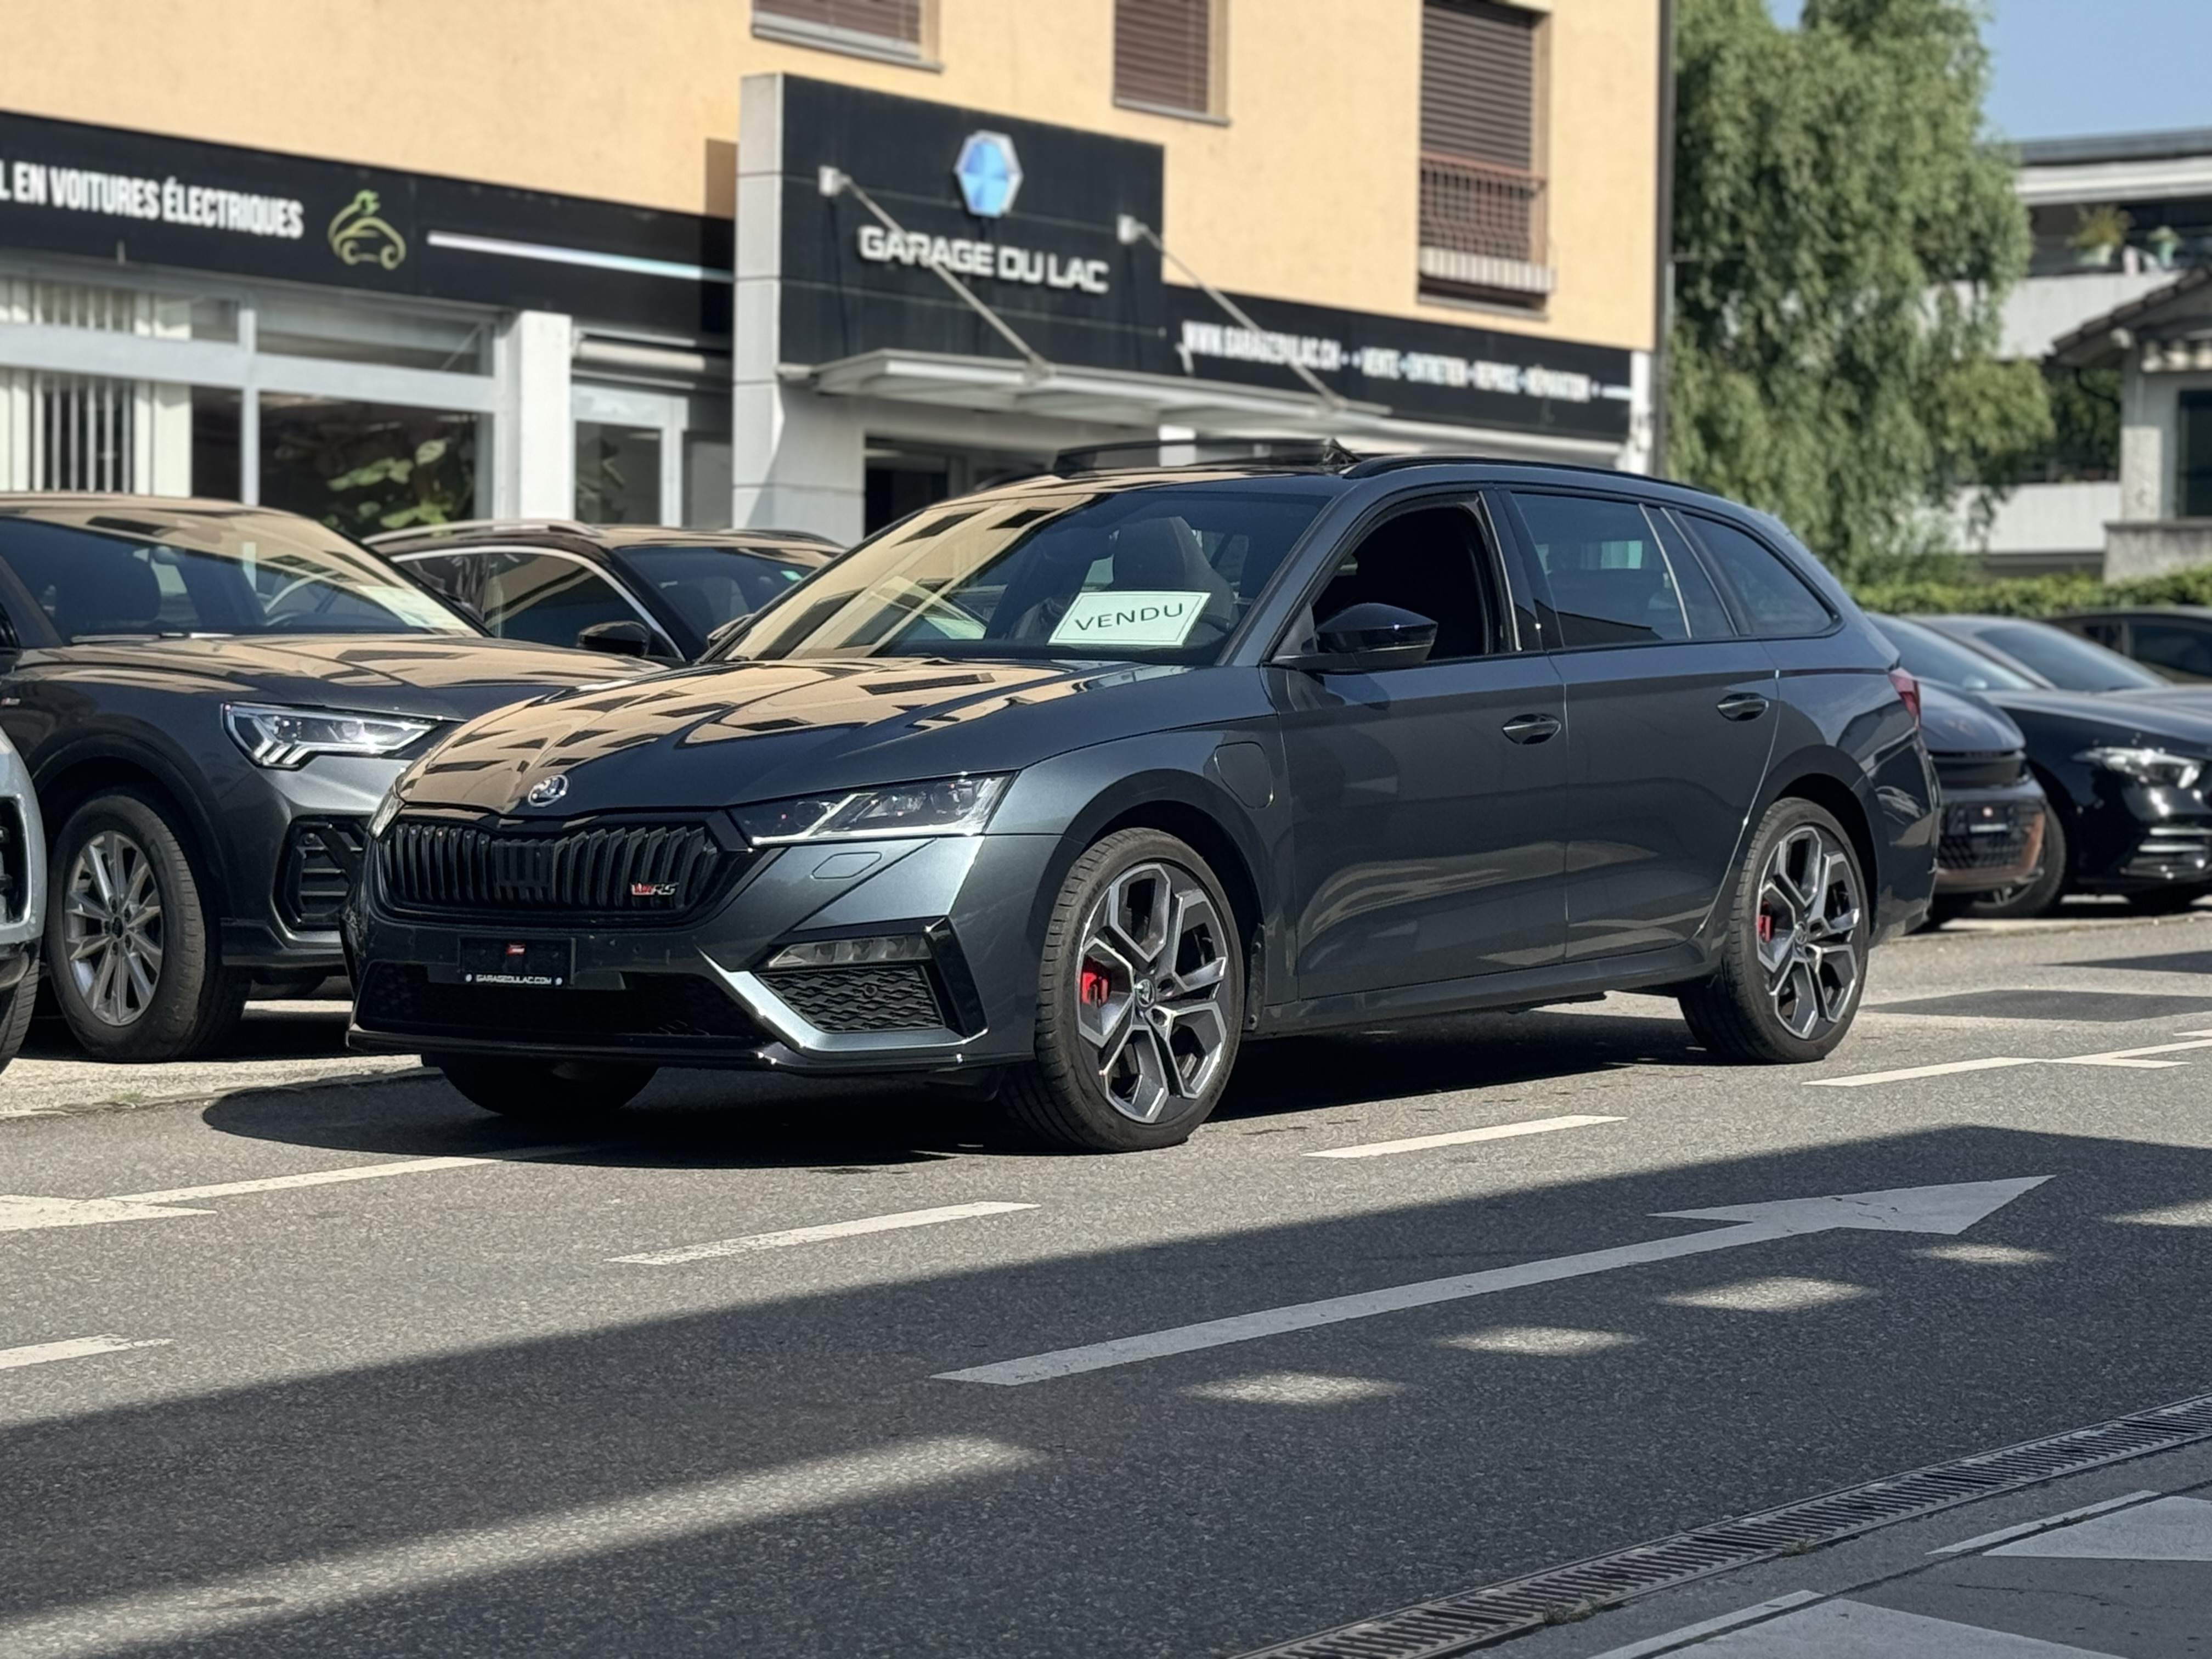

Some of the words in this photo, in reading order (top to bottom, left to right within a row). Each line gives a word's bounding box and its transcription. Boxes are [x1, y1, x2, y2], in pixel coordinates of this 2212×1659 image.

[13, 161, 47, 205] EN
[49, 166, 161, 219] VOITURES
[163, 176, 304, 239] ÉLECTRIQUES
[857, 225, 995, 276] GARAGE
[998, 245, 1044, 283] DU
[1047, 253, 1109, 294] LAC
[1074, 602, 1183, 631] VENDU
